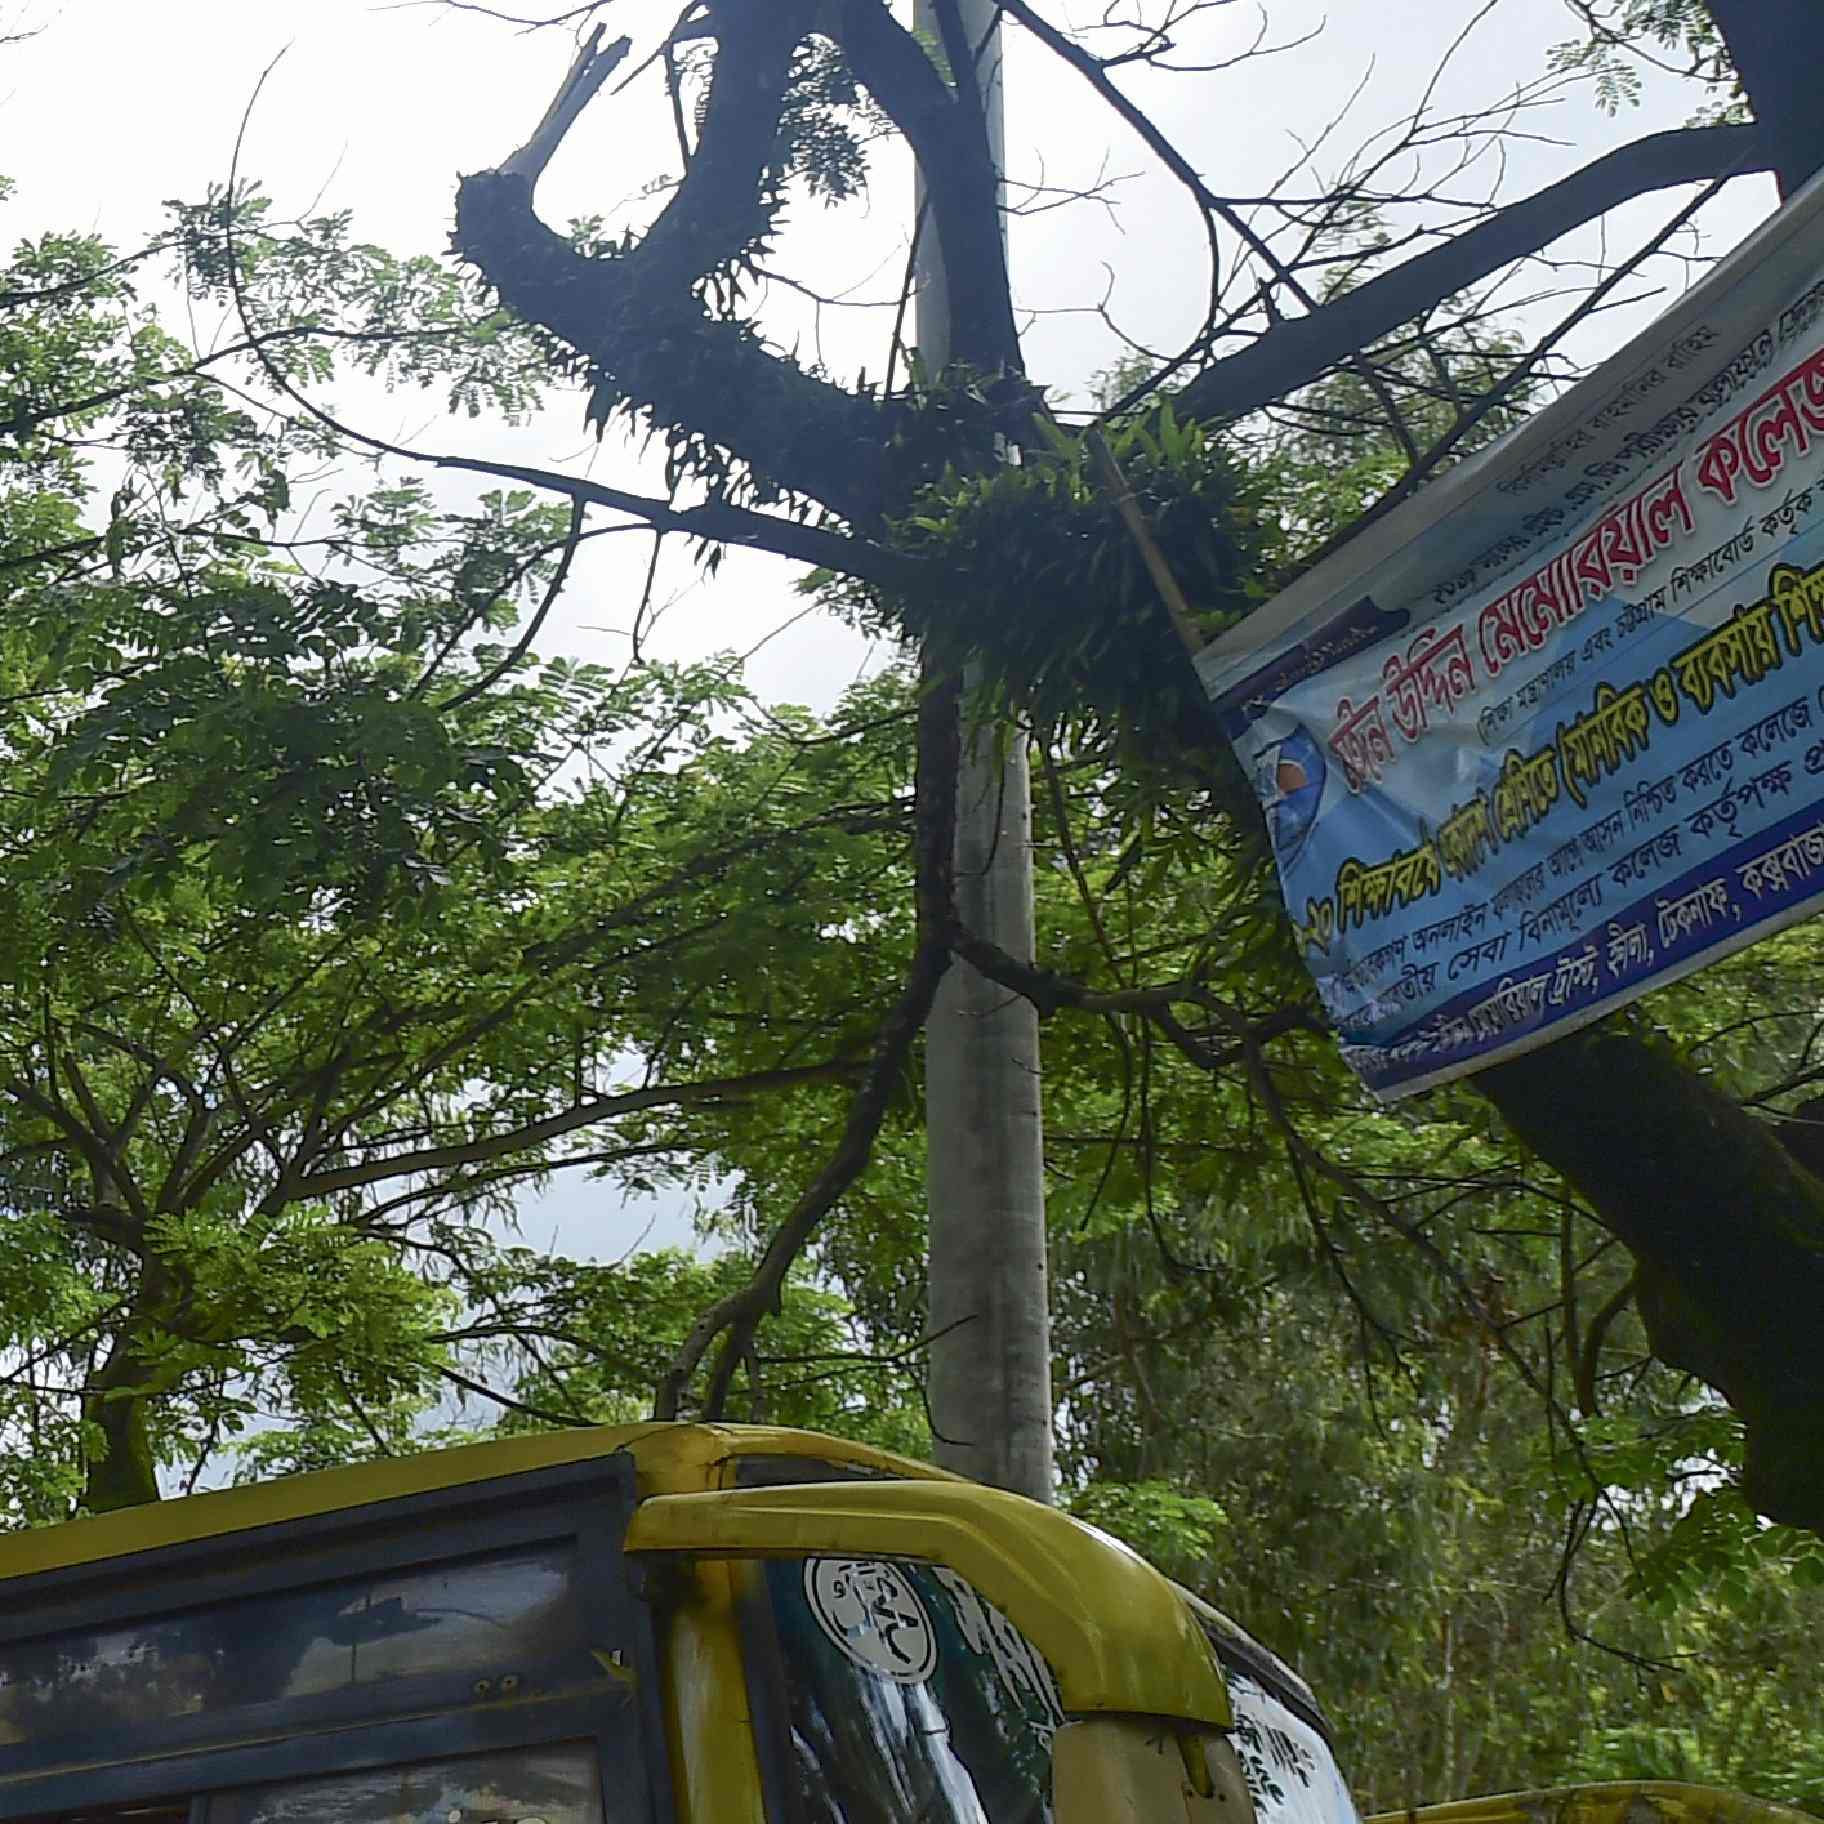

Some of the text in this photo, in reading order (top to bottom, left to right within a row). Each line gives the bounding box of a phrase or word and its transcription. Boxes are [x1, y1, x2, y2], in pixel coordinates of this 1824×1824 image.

[1651, 667, 1680, 727] ও
[1449, 931, 1512, 981] সেবা
[1606, 825, 1682, 887] কলেজ
